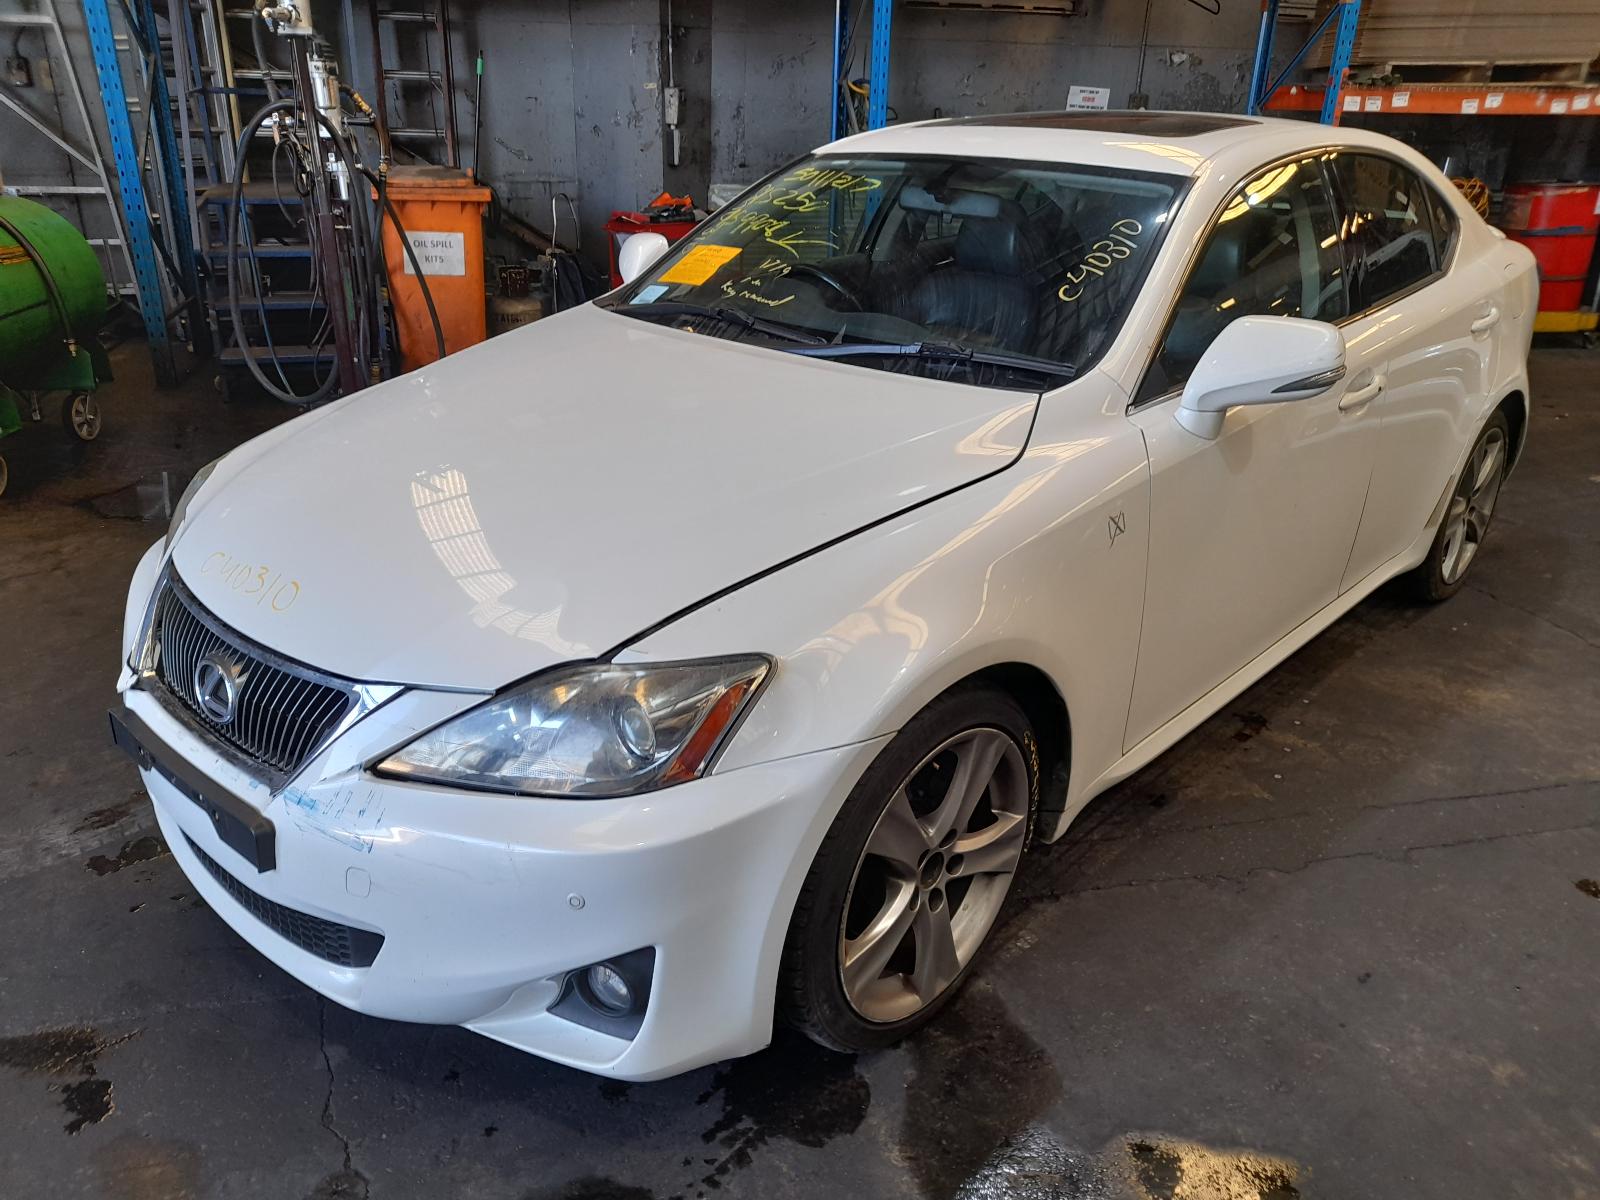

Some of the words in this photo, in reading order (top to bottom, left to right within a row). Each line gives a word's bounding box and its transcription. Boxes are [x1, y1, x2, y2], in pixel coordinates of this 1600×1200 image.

[413, 239, 429, 249] OIL
[430, 239, 454, 249] SPILL
[424, 254, 444, 264] KITS
[1058, 218, 1142, 302] C40310
[200, 551, 301, 612] C40310
